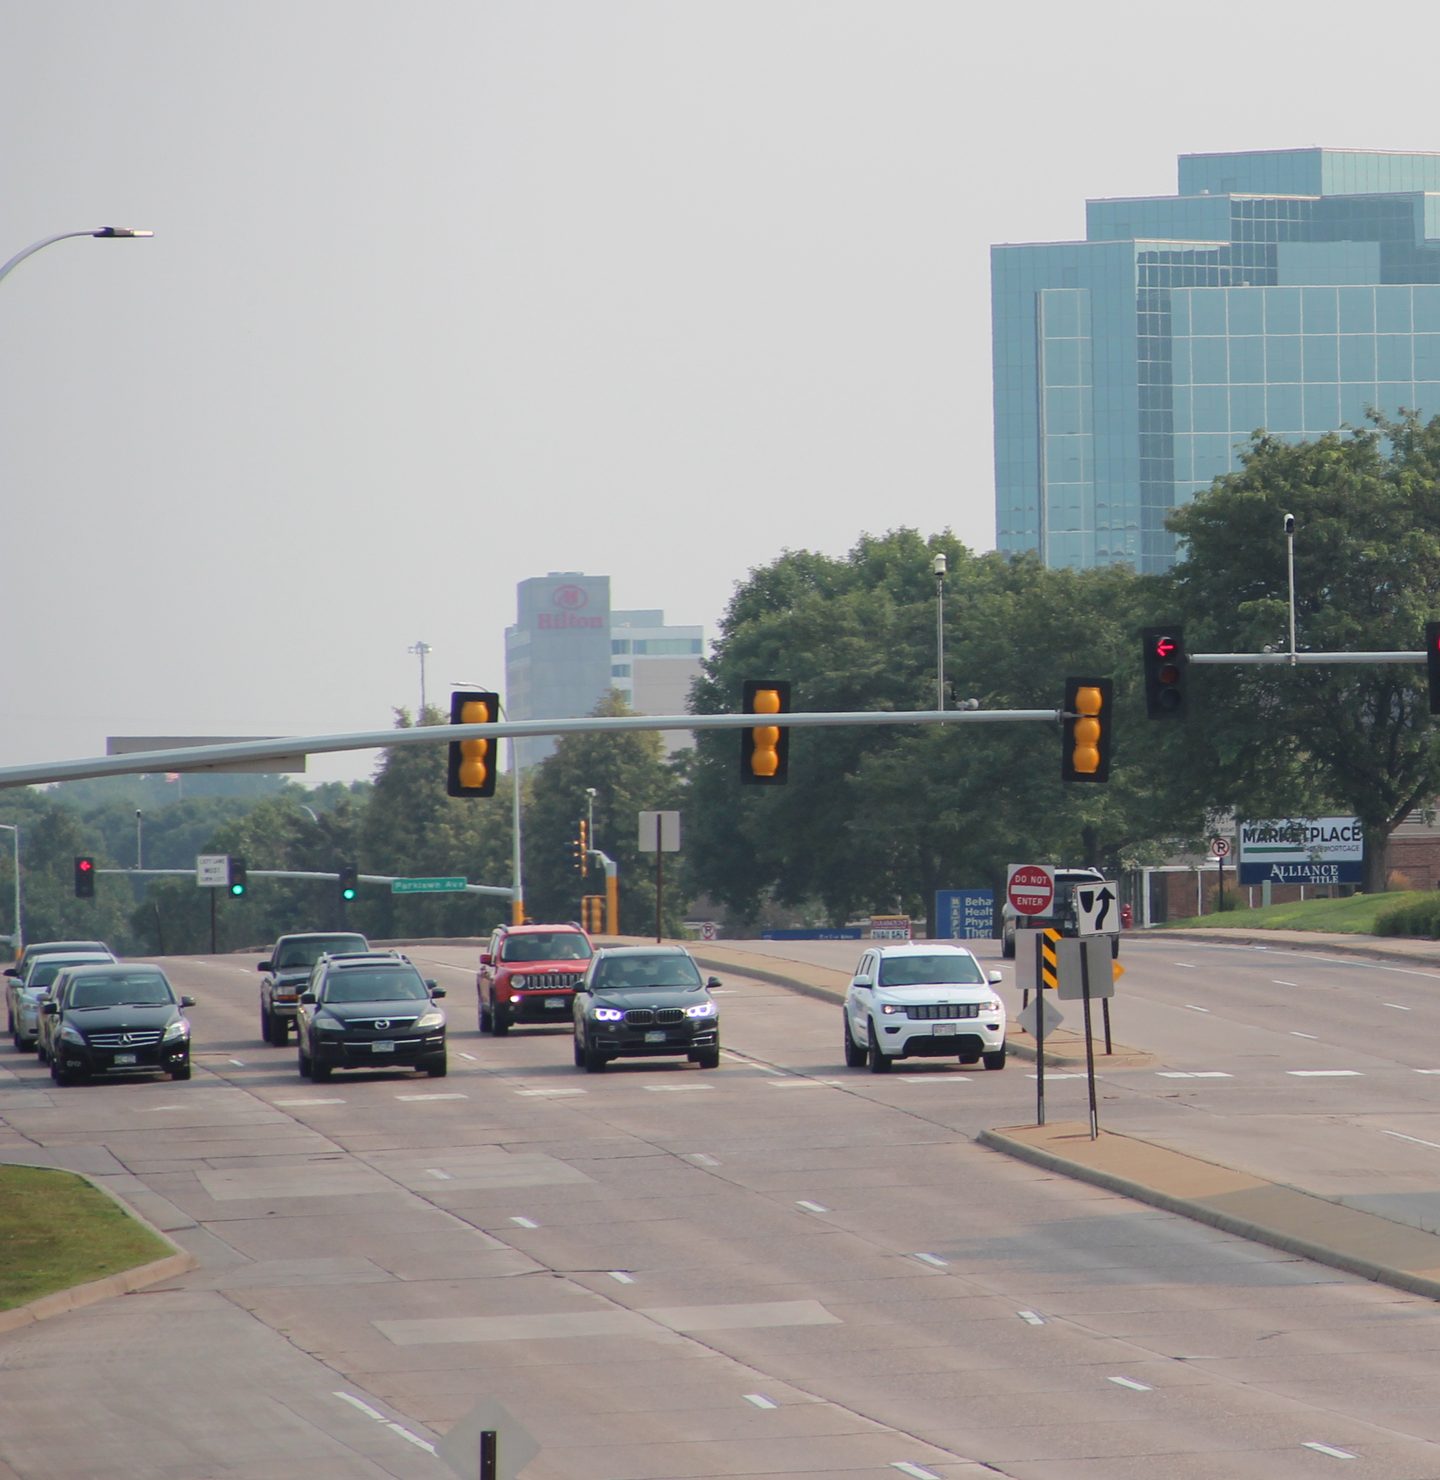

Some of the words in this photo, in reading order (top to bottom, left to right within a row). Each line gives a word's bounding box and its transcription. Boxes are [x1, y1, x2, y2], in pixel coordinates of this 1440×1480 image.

[537, 610, 604, 630] Hilton
[1270, 863, 1339, 883] ALLIANCE
[1014, 874, 1027, 883] DO
[1030, 876, 1047, 884] NOT
[1310, 875, 1339, 884] TITLE
[1017, 897, 1043, 906] ENTER
